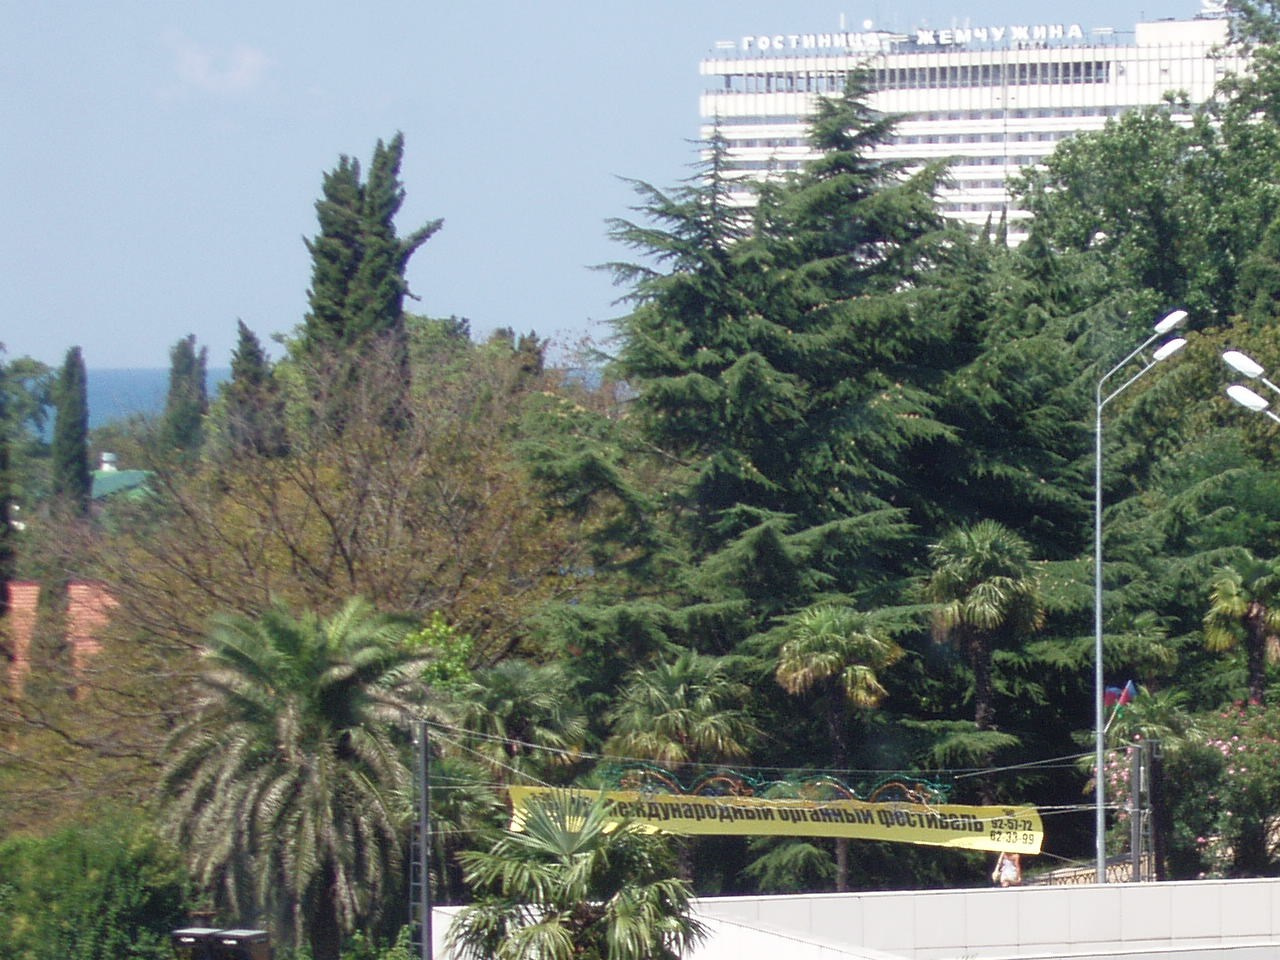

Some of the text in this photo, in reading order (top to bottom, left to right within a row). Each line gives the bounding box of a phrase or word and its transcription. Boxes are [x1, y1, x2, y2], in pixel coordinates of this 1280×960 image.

[742, 24, 1084, 50] ГОСТИНИЦА ЖЕМЧУЖИНА
[877, 809, 984, 832] фестиваль
